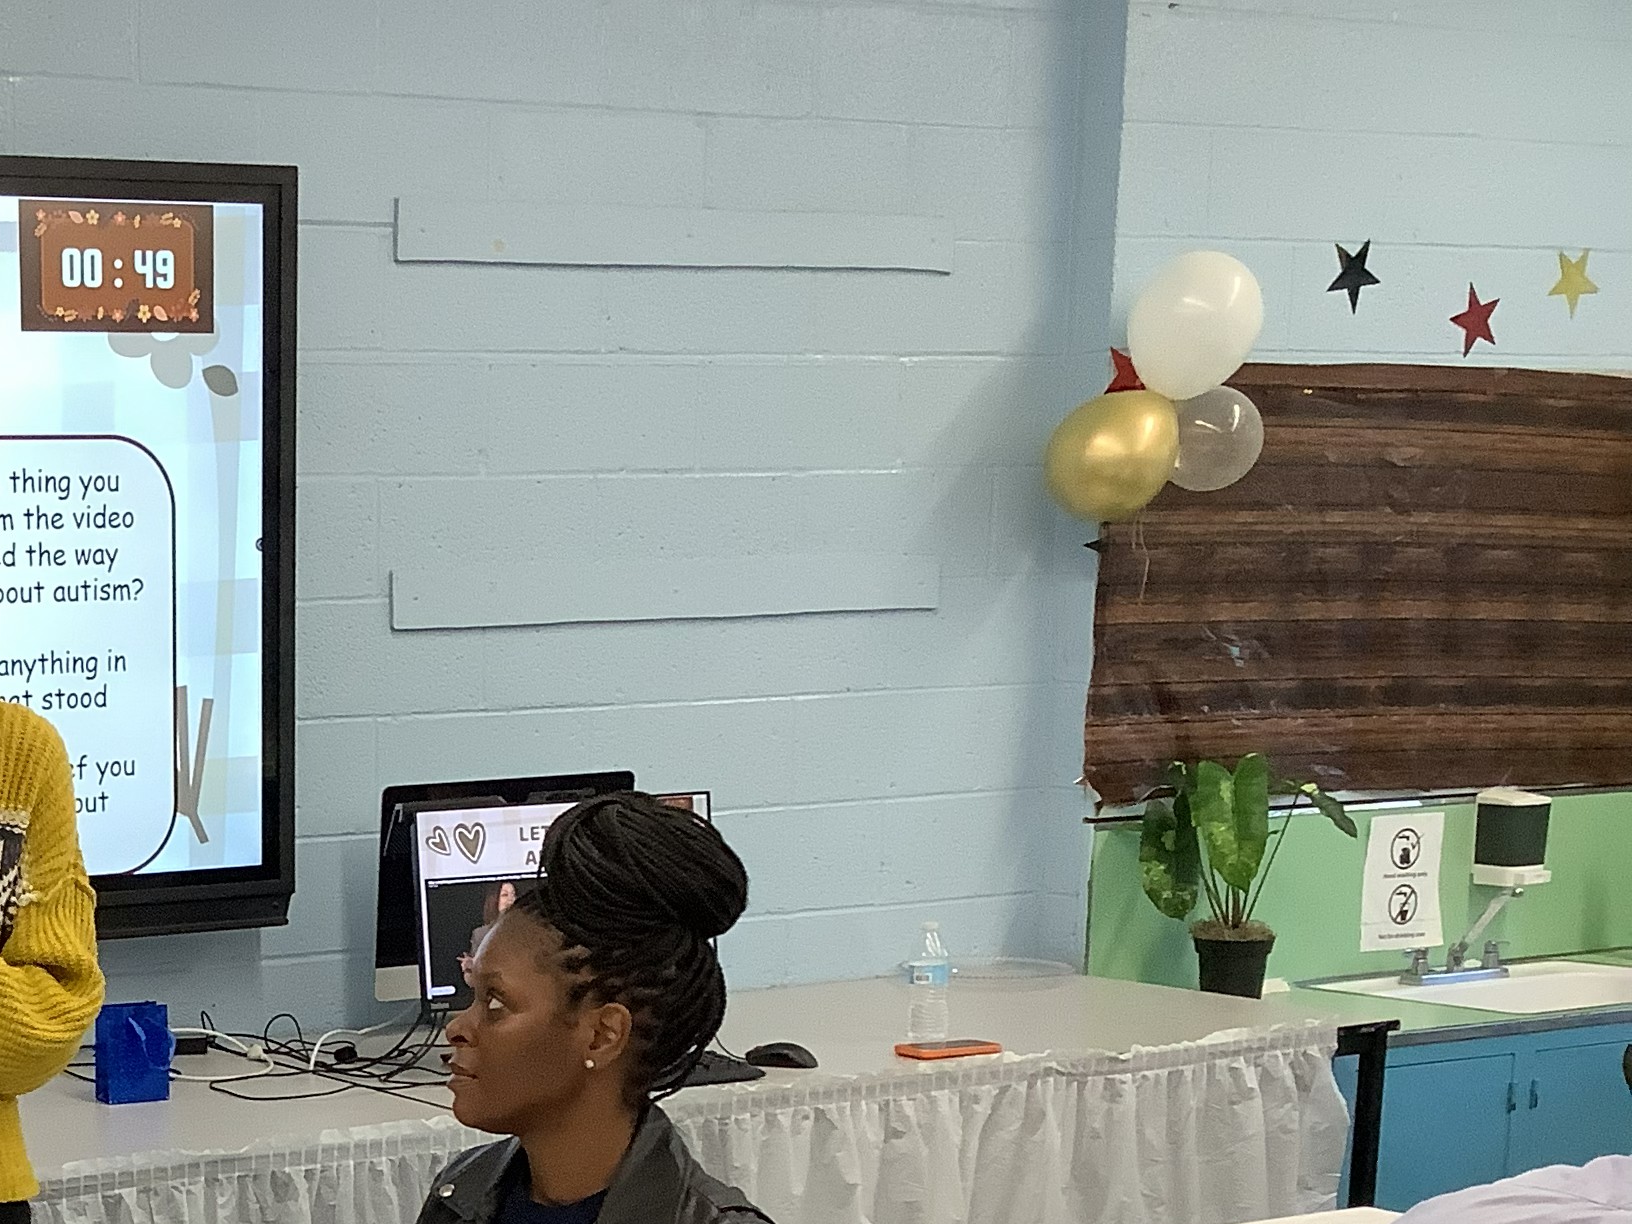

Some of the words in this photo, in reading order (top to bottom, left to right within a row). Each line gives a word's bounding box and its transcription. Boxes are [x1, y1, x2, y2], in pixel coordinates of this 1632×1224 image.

[9, 468, 71, 500] thing
[78, 475, 120, 501] you
[23, 505, 65, 530] the
[72, 504, 135, 529] video
[25, 541, 67, 567] the
[75, 548, 119, 573] way
[53, 578, 144, 602] autism?
[107, 649, 127, 672] in
[41, 683, 107, 710] stood
[95, 760, 135, 786] you
[75, 791, 109, 813] out
[519, 825, 550, 842] LET
